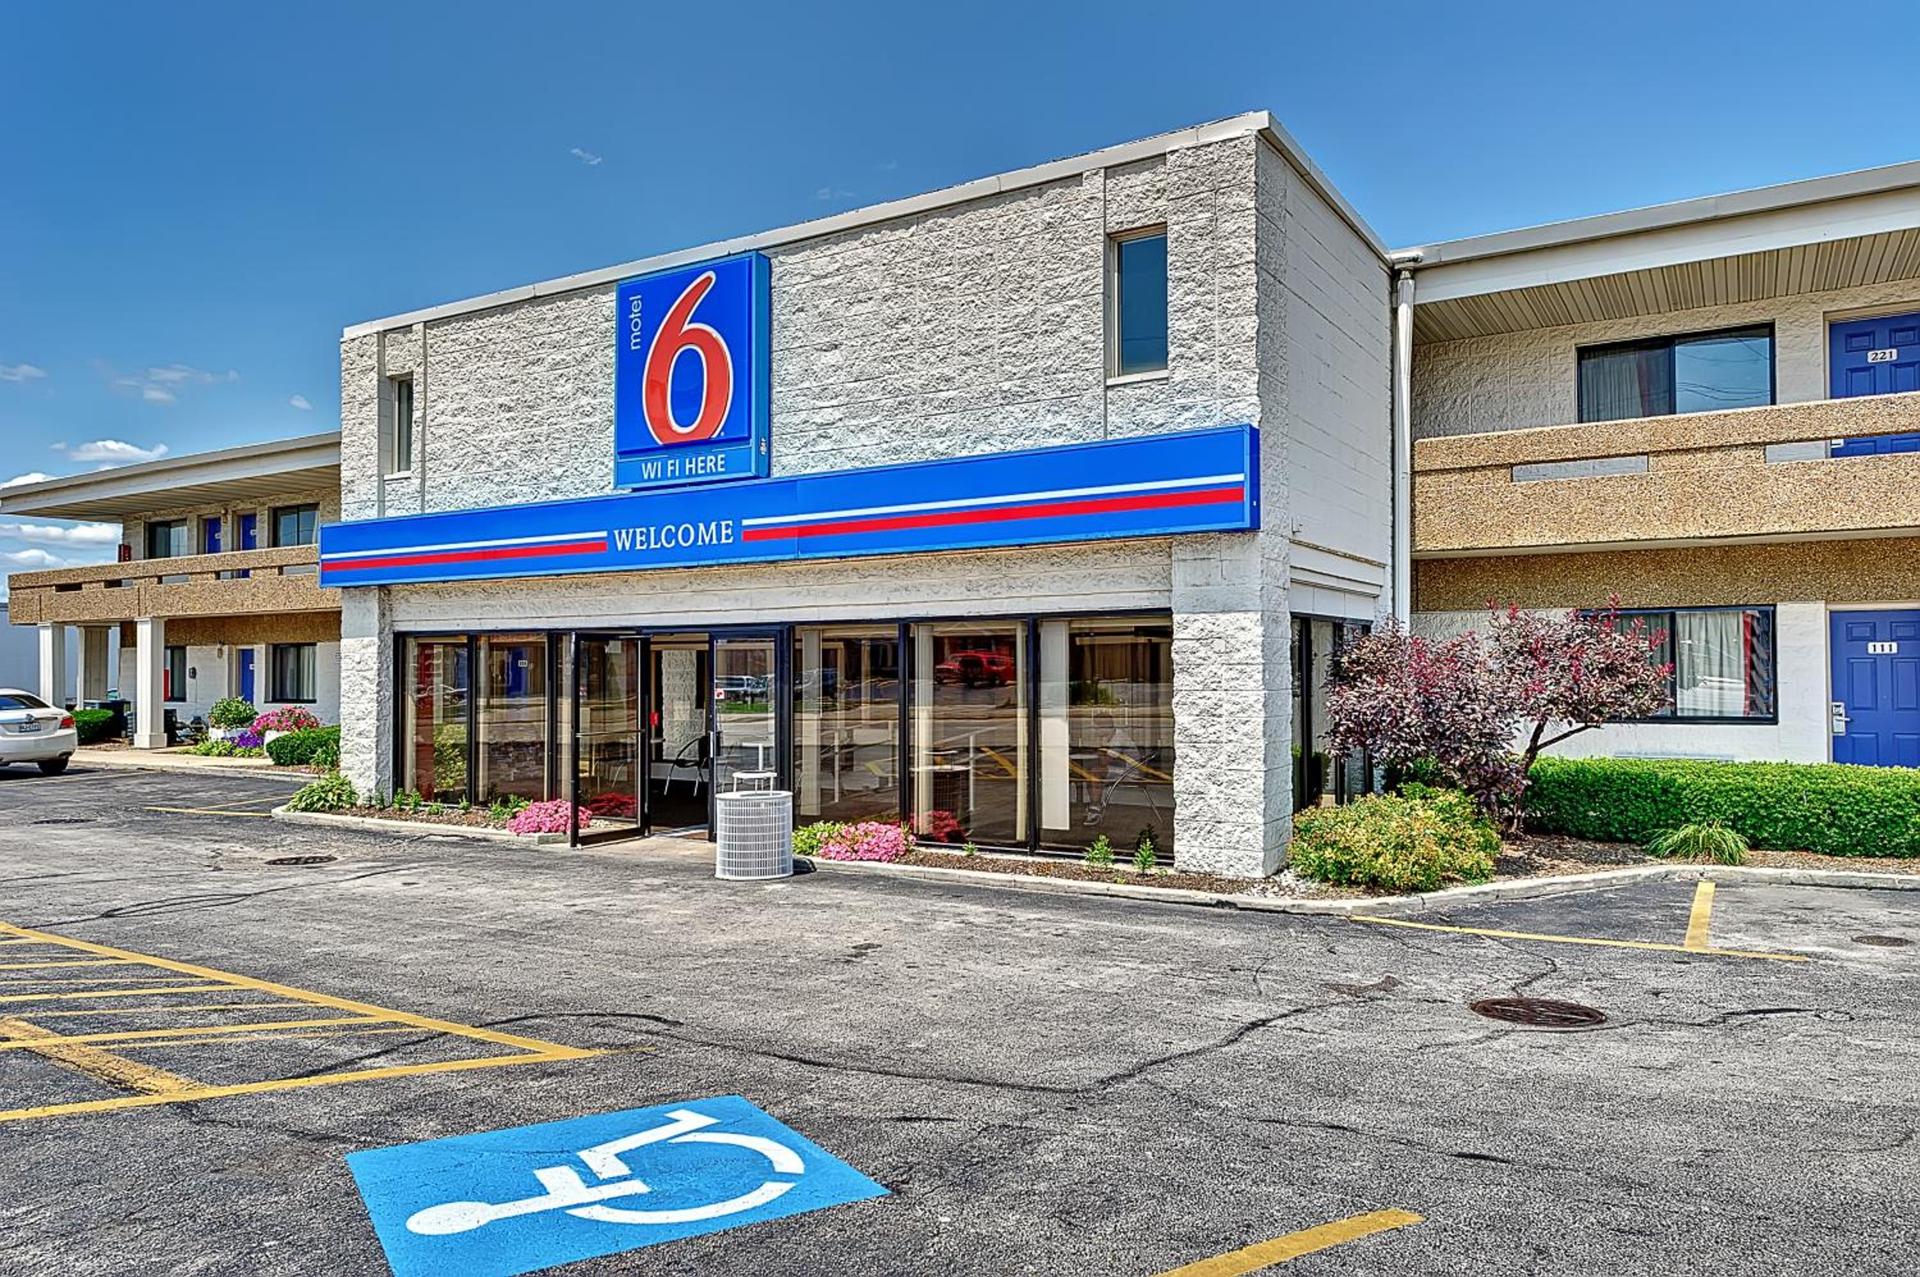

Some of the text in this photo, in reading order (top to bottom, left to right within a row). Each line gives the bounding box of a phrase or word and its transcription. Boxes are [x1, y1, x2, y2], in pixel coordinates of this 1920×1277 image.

[629, 295, 642, 350] motel
[642, 270, 734, 446] 6
[1871, 351, 1893, 361] 221
[641, 454, 726, 480] WI FI HERE
[613, 520, 734, 552] WELCOME
[1872, 643, 1892, 652] 111
